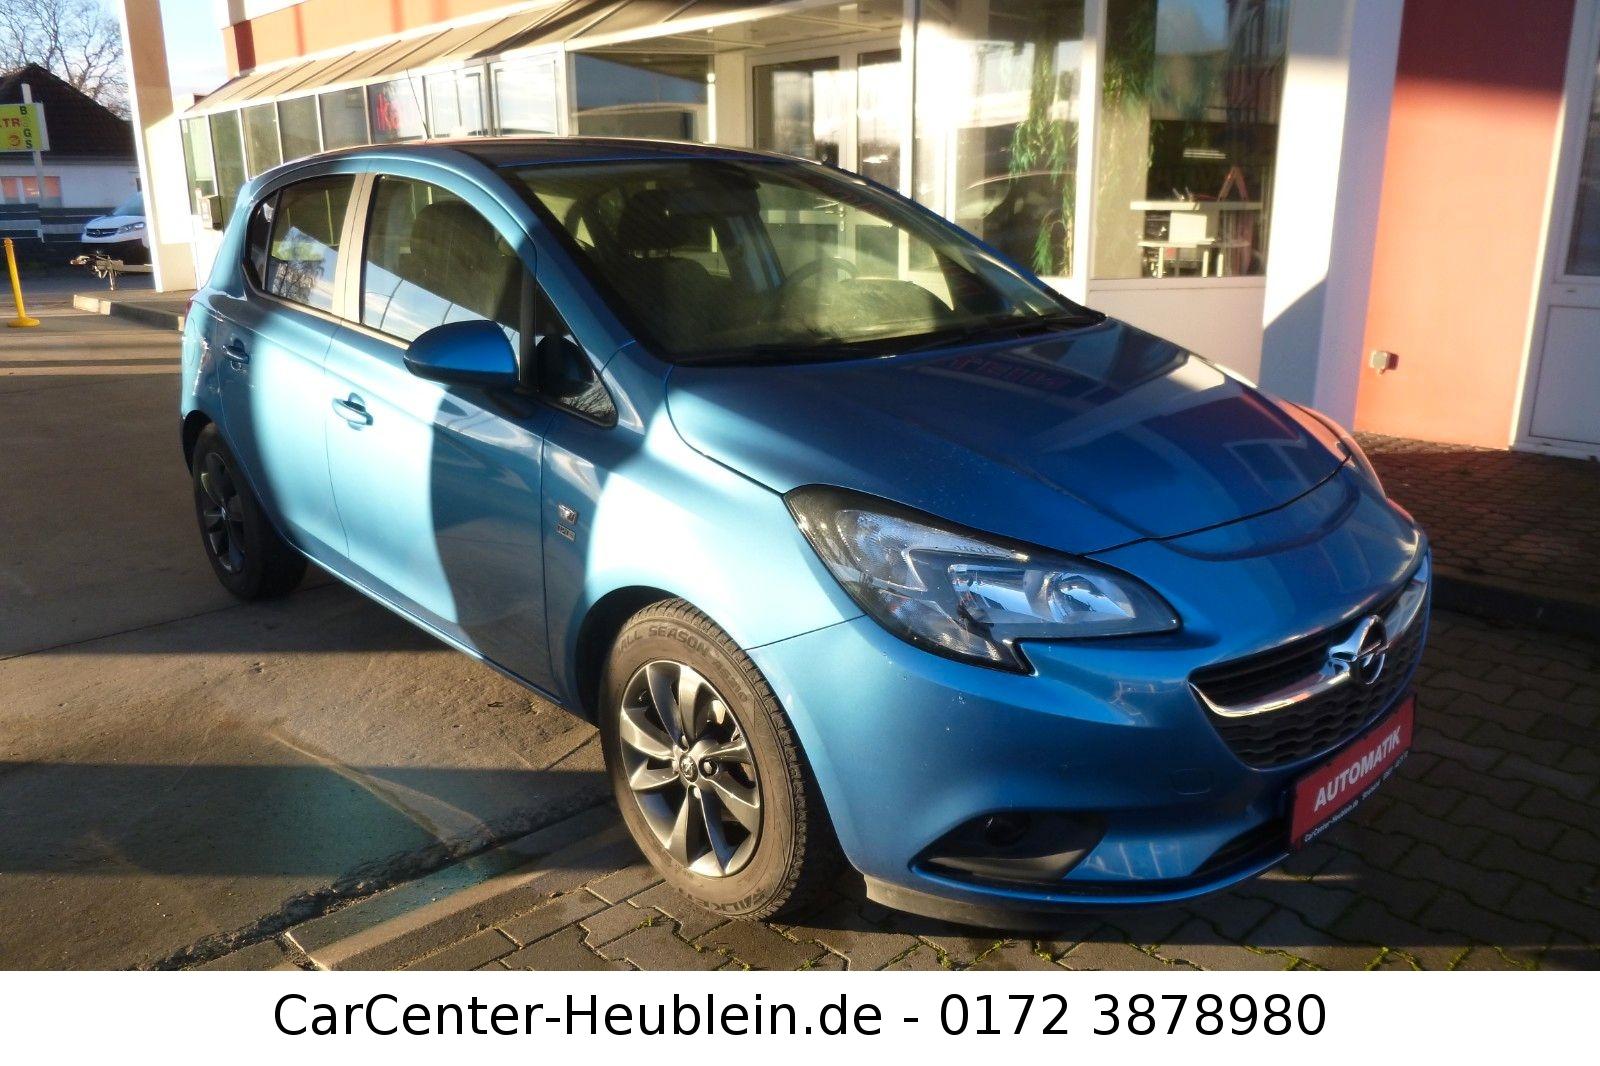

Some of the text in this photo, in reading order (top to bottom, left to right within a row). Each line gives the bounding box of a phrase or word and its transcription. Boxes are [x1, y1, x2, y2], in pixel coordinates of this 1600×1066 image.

[0, 117, 21, 128] TR
[619, 626, 711, 656] ALL SEASON
[1314, 726, 1401, 812] AUTOMATIK
